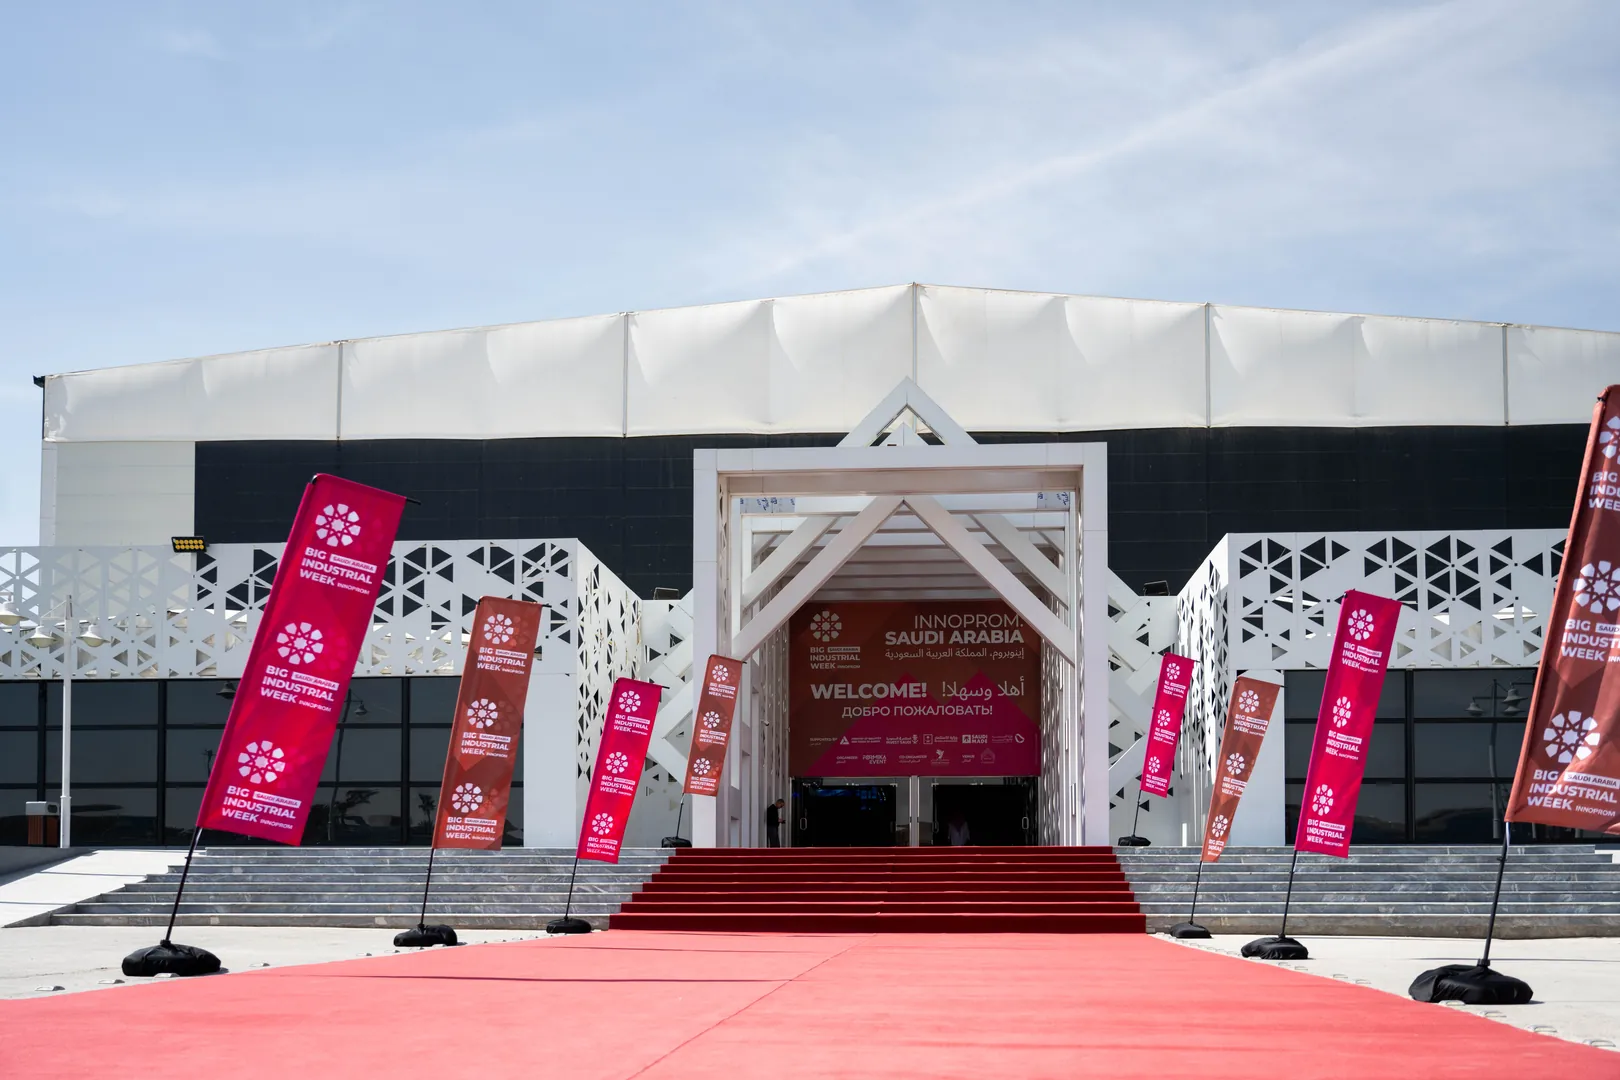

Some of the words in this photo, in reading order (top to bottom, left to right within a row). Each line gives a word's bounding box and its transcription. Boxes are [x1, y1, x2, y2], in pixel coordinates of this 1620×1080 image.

[1592, 471, 1618, 482] BIG
[305, 547, 327, 560] BIG
[300, 568, 336, 586] WEEK
[302, 558, 372, 584] INDUSTRIAL
[914, 614, 1024, 629] INNOPROM.
[1565, 619, 1590, 631] BIG
[885, 630, 944, 646] SAUDI
[949, 630, 1024, 644] ARABIA
[1562, 632, 1620, 648] INDUST
[1344, 642, 1355, 650] BIG
[885, 648, 924, 660] السعودية
[926, 648, 952, 660] العربية
[955, 648, 987, 658] المملكة
[1342, 650, 1380, 666] INDUSTRIAL
[1561, 646, 1606, 661] WEEK
[477, 662, 501, 671] WEEK
[478, 654, 526, 667] INDUSTRIAL
[1342, 658, 1360, 669] WEEK
[266, 665, 288, 678] BIG
[262, 676, 334, 702] INDUSTRIAL
[709, 687, 734, 695] INDUSTRIAL
[810, 682, 927, 700] WELCOME!
[942, 681, 992, 700] وسهلا!
[997, 676, 1024, 696] أهلا
[261, 687, 298, 703] WEEK
[842, 706, 890, 718] ДОБРО
[894, 705, 992, 716] ПОЖАЛОВАТЬ!
[614, 720, 648, 731] INDUSTRIAL
[1328, 730, 1336, 738] BIG
[461, 740, 509, 750] INDUSTRIAL
[1533, 769, 1558, 780] BIG
[1568, 774, 1591, 782] SAUDI
[1592, 777, 1616, 787] ARABIA
[227, 785, 250, 798] BIG
[600, 781, 633, 791] INDUSTRIAL
[1529, 783, 1617, 803] INDUSTRIAL
[224, 796, 296, 819] INDUSTRIAL
[1527, 796, 1574, 810] WEEK
[1575, 805, 1616, 817] INNOPROM
[222, 808, 259, 822] WEEK
[446, 825, 496, 834] INDUSTRIAL
[1307, 827, 1345, 840] INDUSTRIAL
[1307, 835, 1324, 844] WEEK
